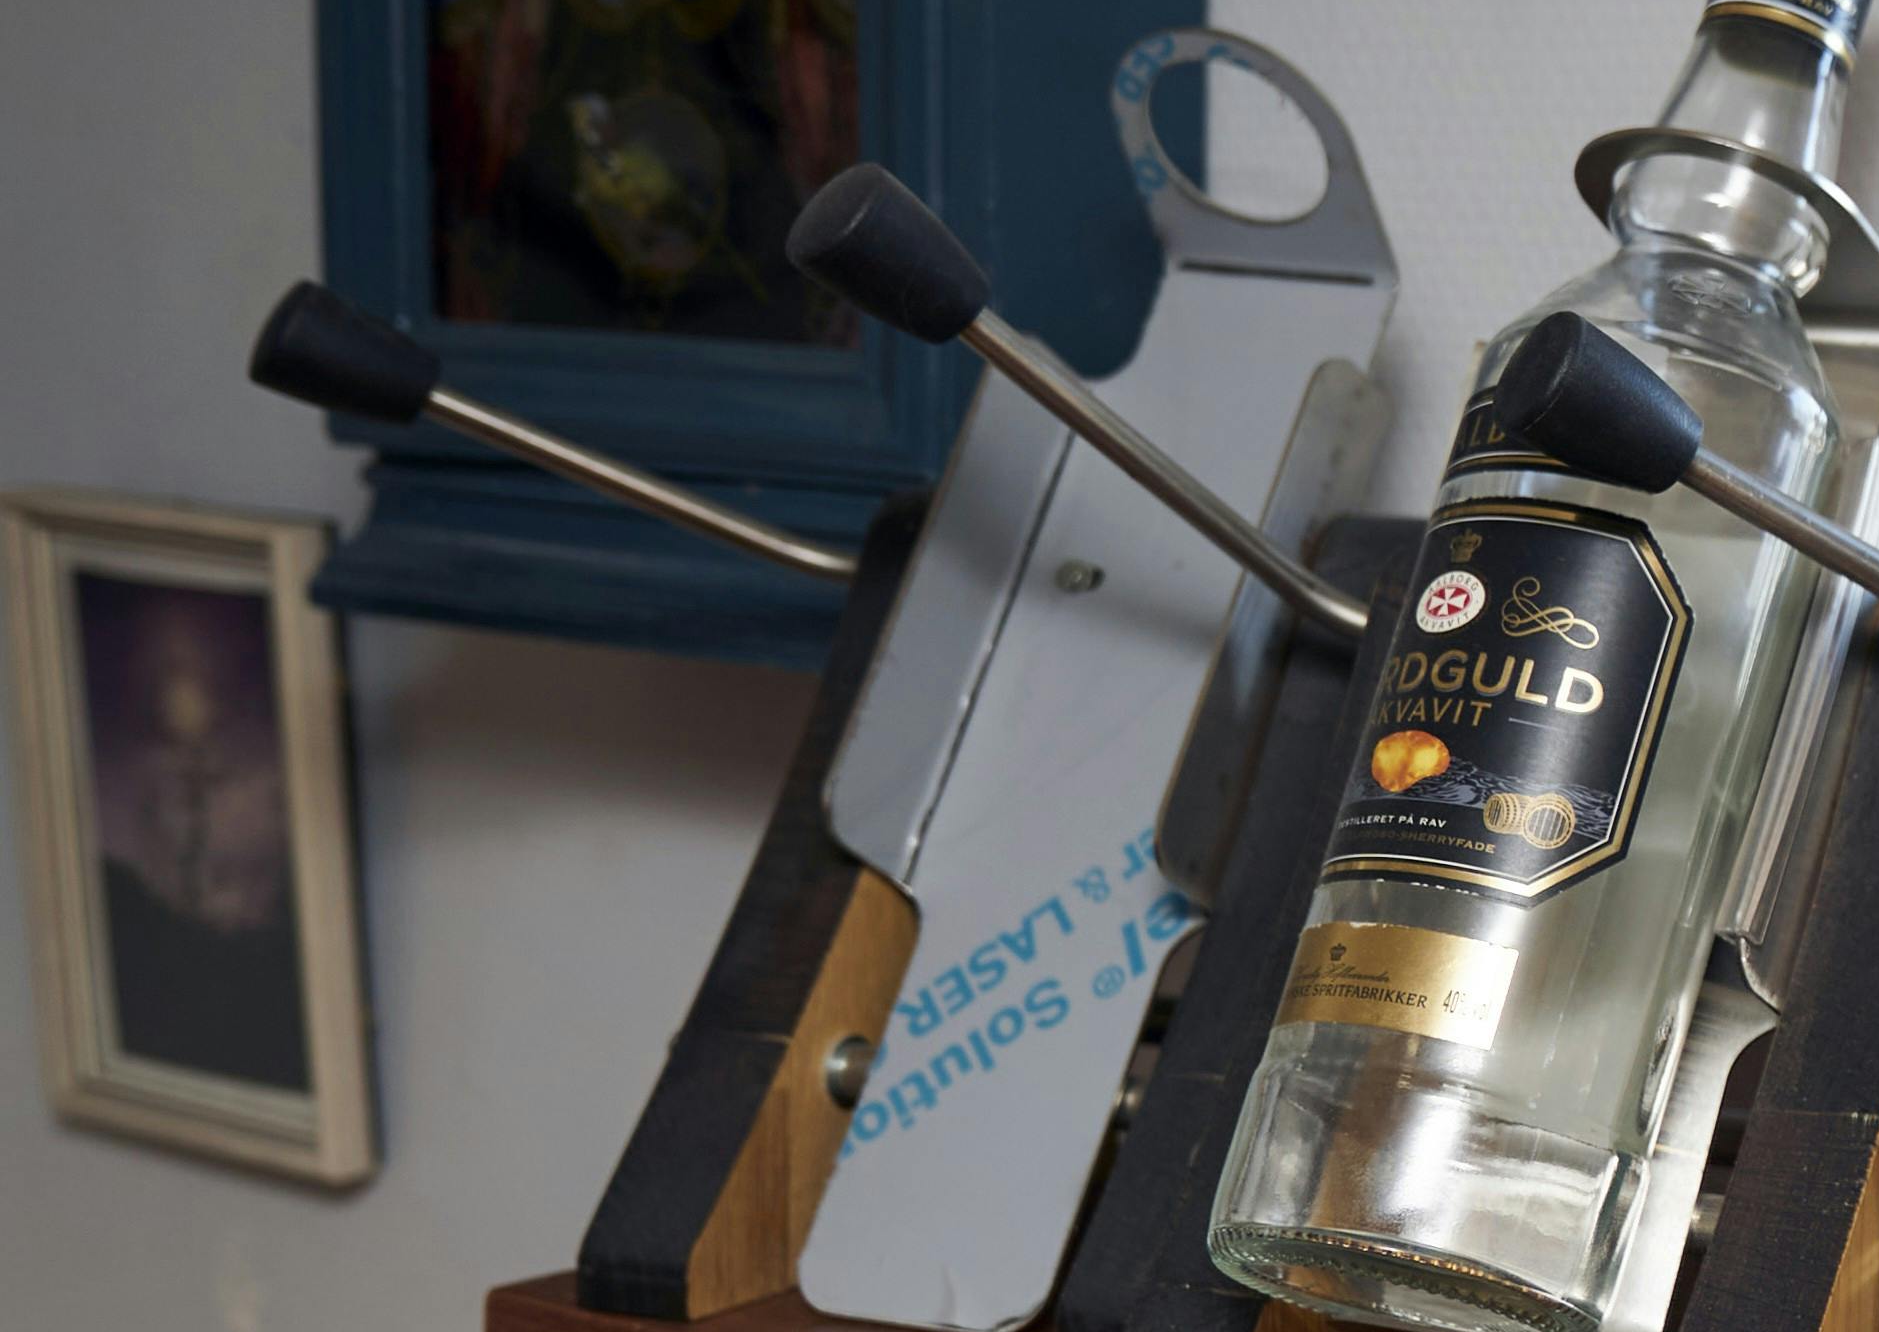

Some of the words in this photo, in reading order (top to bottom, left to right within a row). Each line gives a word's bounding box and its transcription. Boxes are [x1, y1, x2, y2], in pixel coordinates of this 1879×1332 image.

[1398, 813, 1414, 826] PÅ
[1419, 817, 1447, 828] RAV
[895, 896, 1074, 1038] LASER
[1312, 984, 1428, 1009] SPRITFABRIKKER
